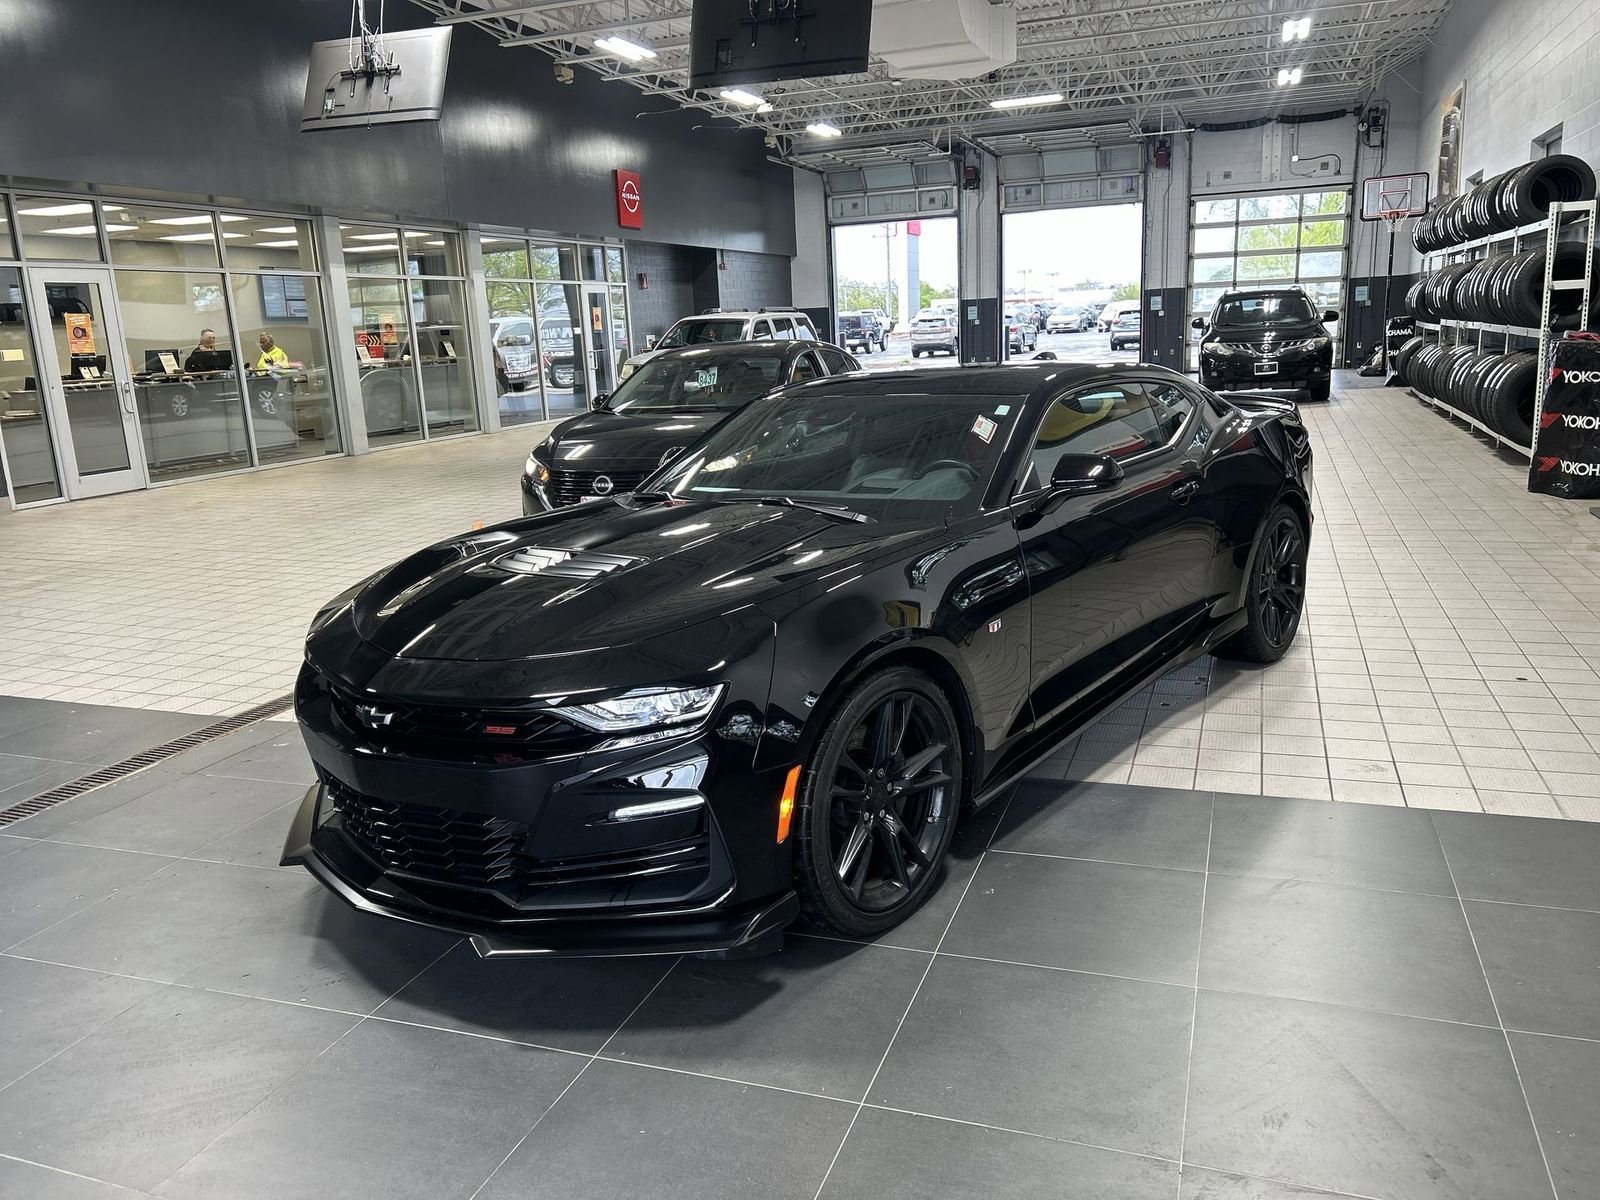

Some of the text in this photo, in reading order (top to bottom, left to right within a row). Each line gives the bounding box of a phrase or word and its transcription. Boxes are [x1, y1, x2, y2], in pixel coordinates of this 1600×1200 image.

[622, 192, 640, 201] NISSAN
[700, 373, 715, 386] 8437
[1560, 460, 1600, 476] YOKOH
[485, 726, 516, 734] SS
